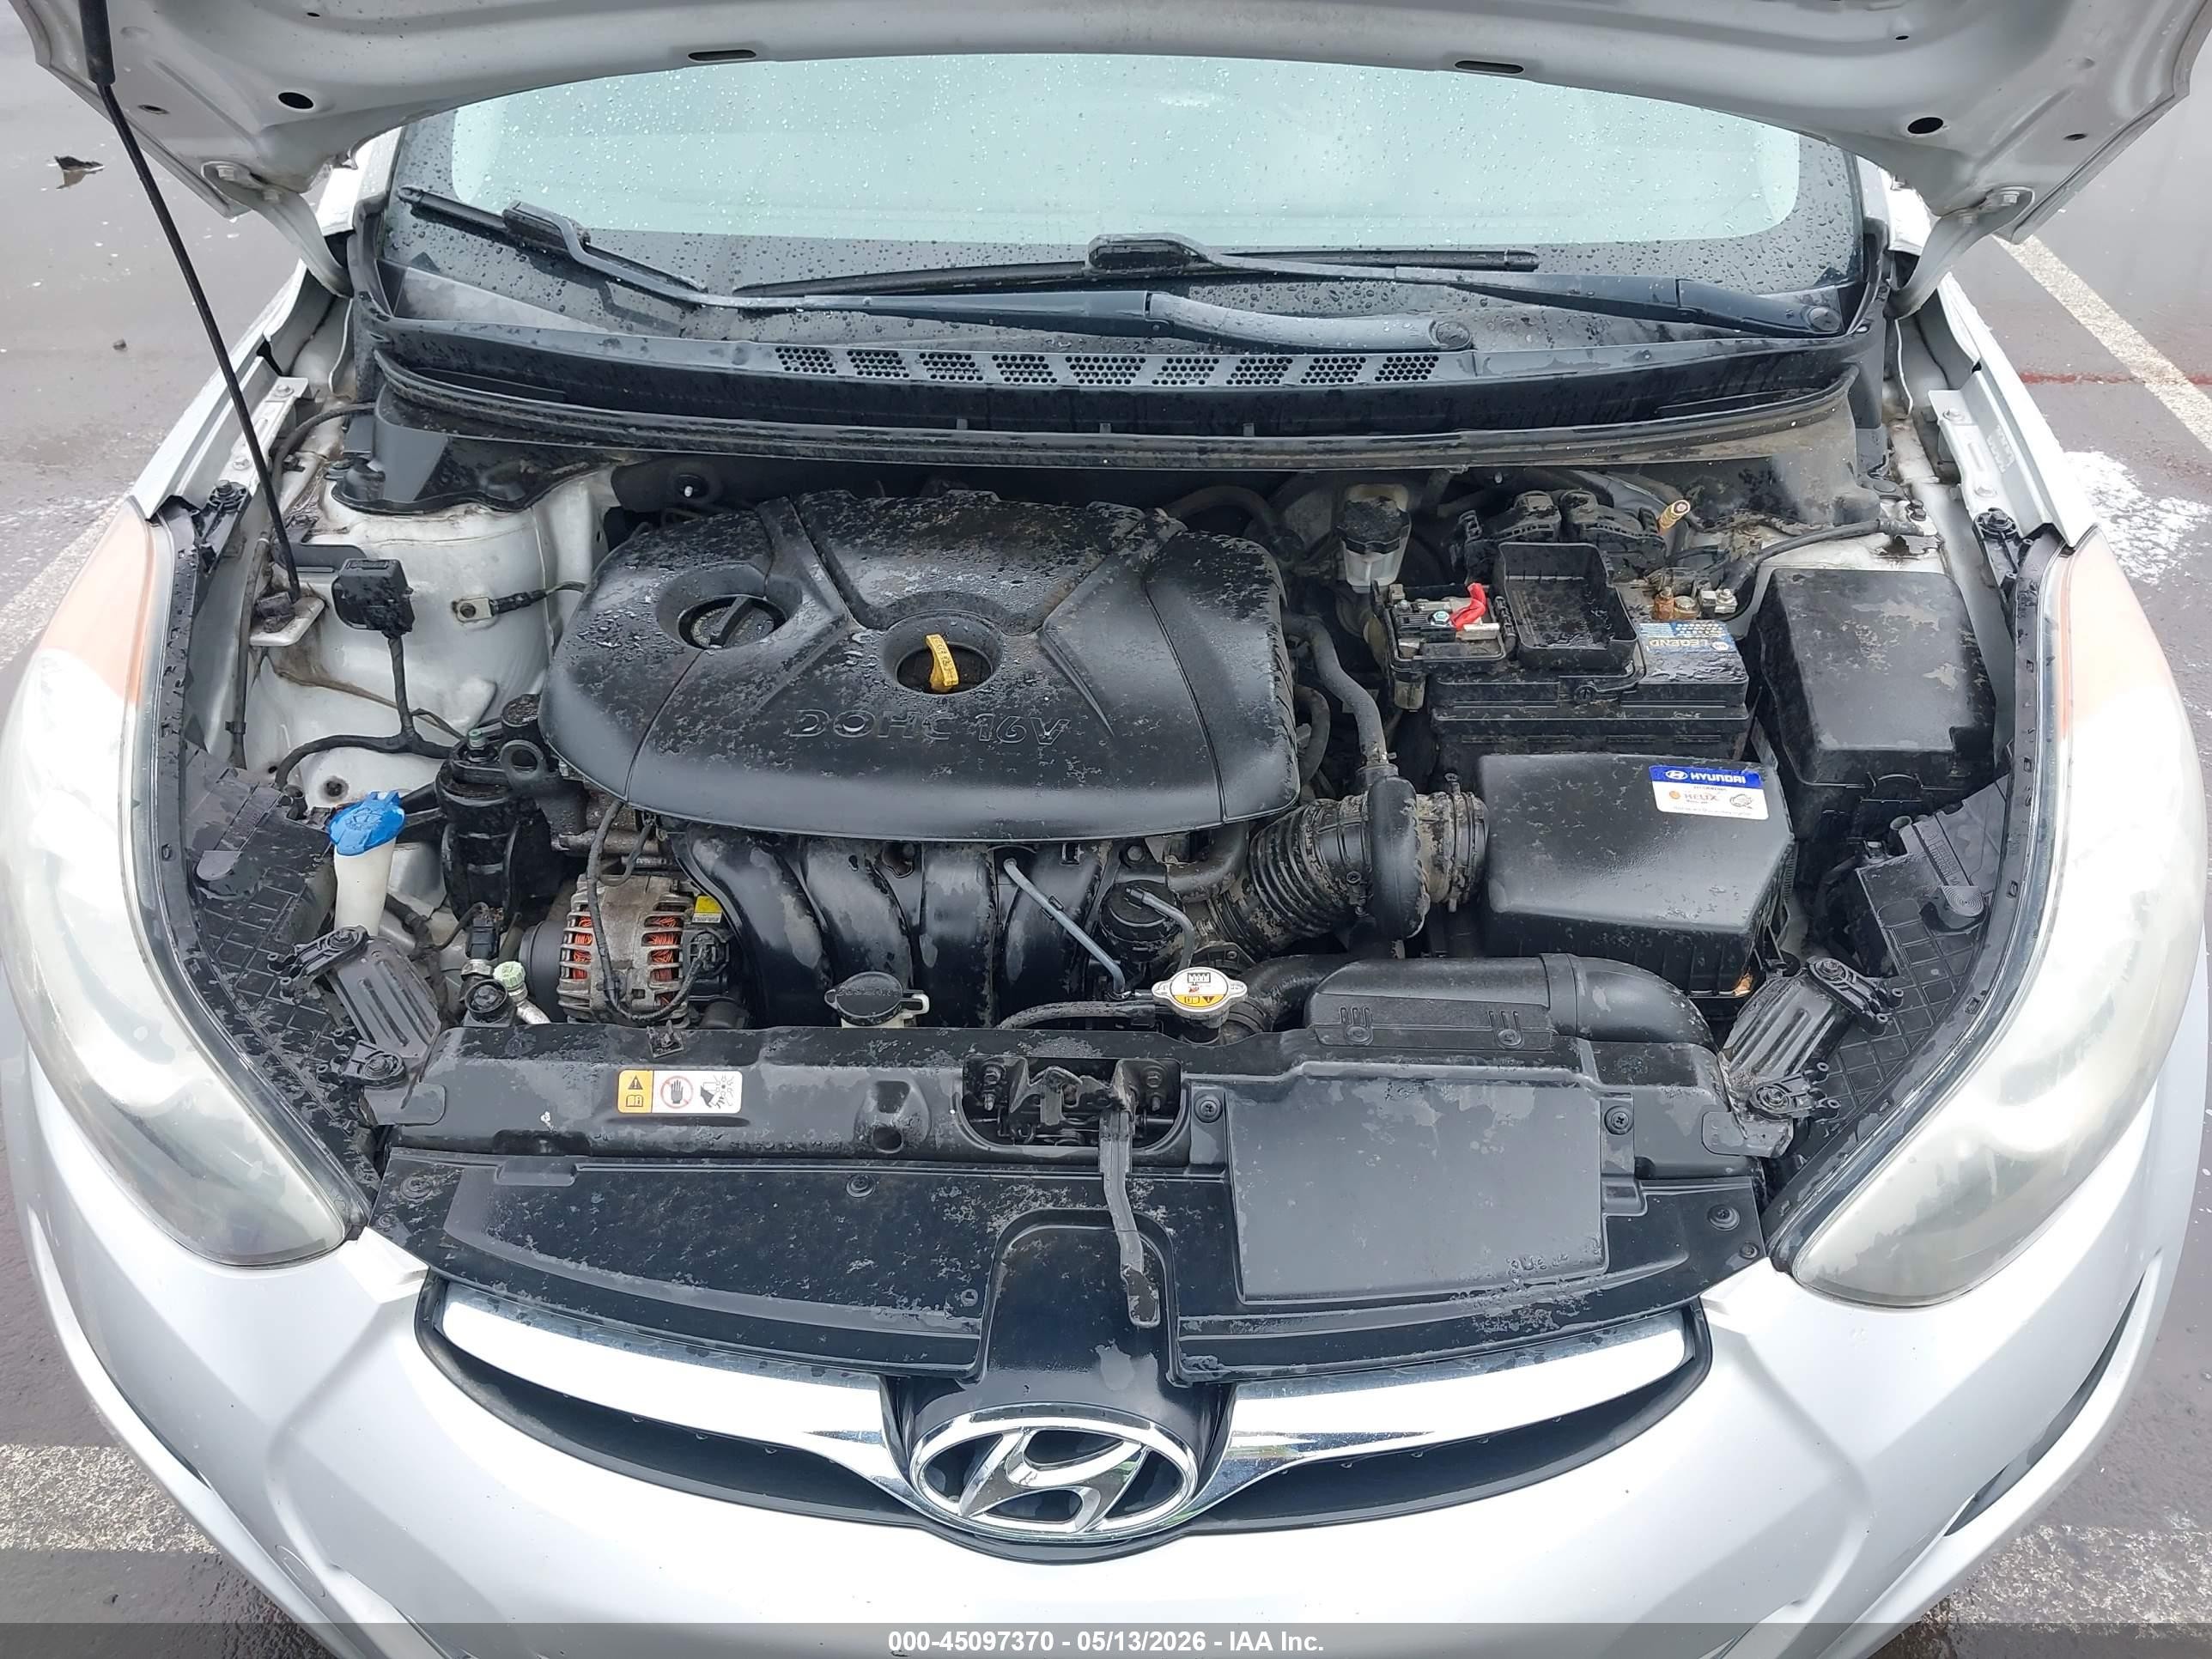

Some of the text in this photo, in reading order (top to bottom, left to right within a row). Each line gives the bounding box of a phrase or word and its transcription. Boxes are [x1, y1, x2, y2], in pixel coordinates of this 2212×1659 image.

[787, 709, 1072, 745] DOHC 16V
[1690, 772, 1746, 784] HYUNDAI
